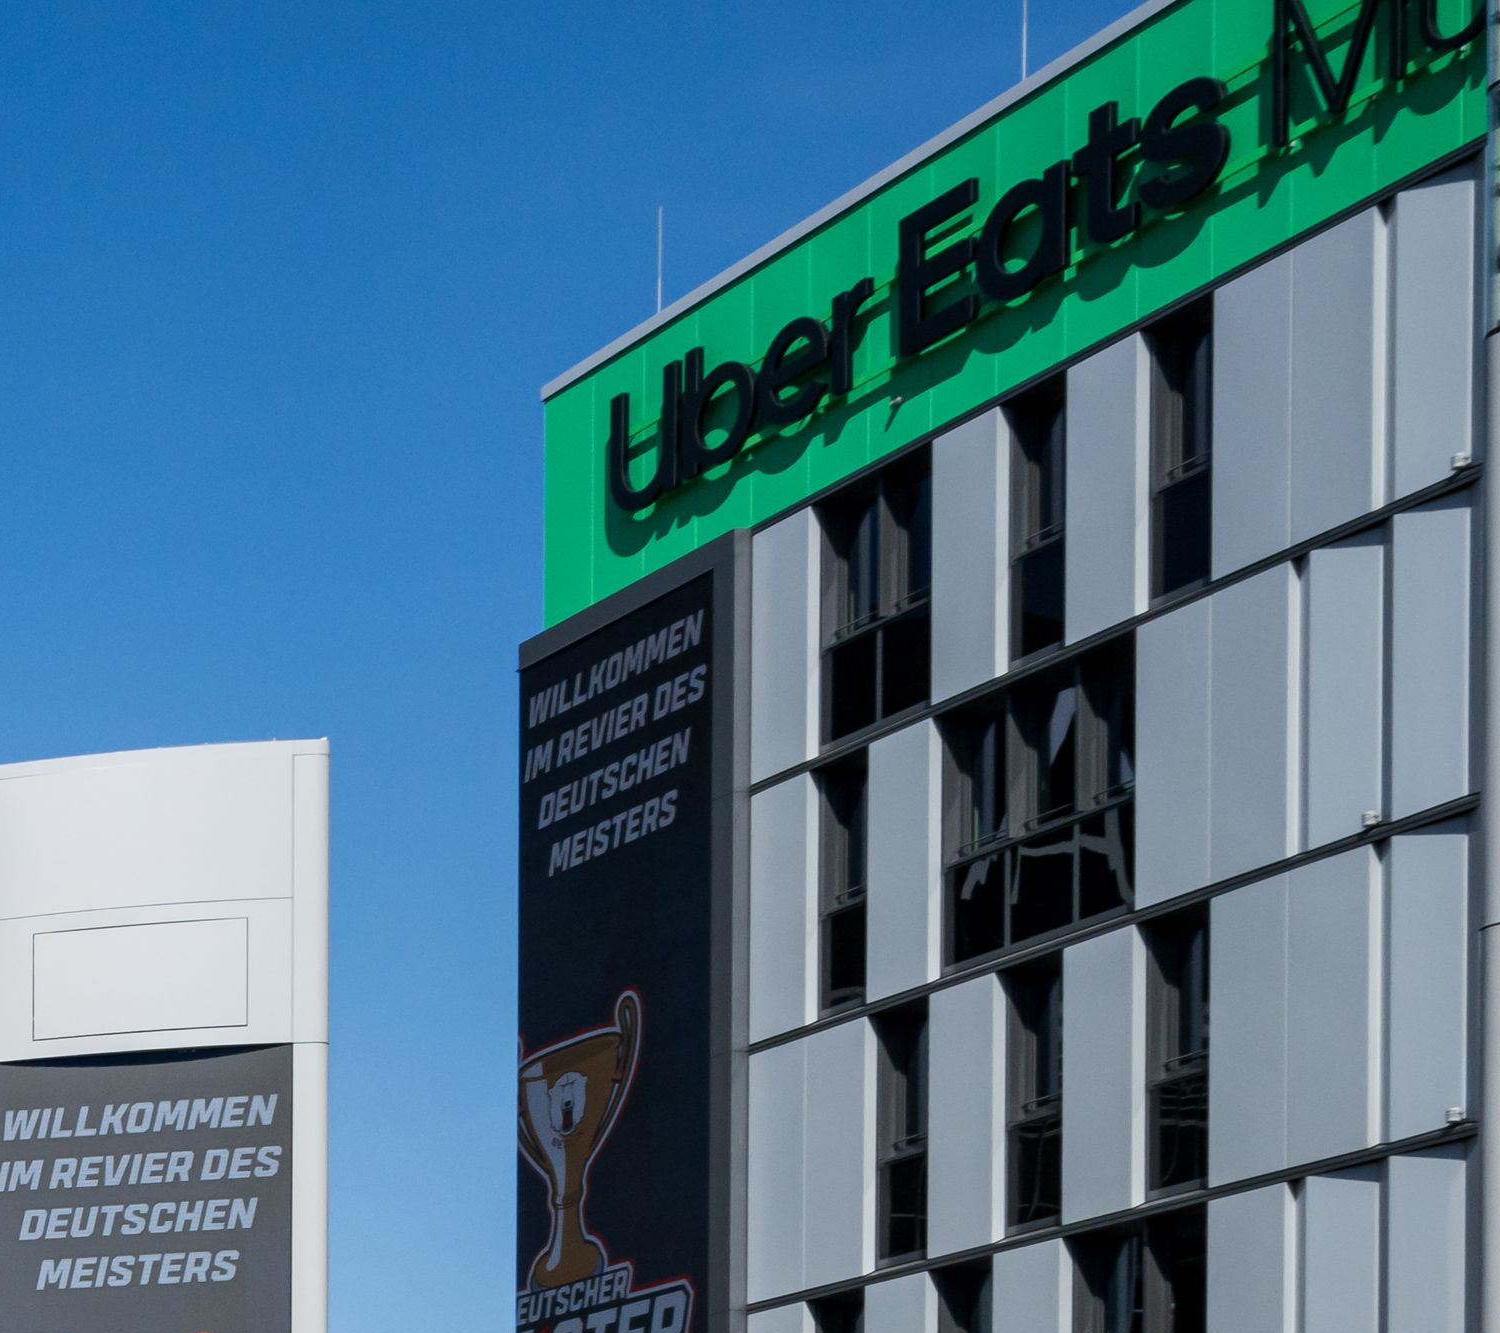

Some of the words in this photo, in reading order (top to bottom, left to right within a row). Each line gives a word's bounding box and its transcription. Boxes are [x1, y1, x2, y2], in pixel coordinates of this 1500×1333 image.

[610, 277, 875, 513] Uber
[900, 76, 1227, 356] Eats
[527, 607, 705, 730] WILLKOMMEN
[524, 743, 553, 784] IM
[556, 704, 647, 770] REVIER
[653, 664, 707, 723] DES
[538, 727, 692, 831] DEUTSCHEN
[549, 788, 679, 879] MEISTERS
[3, 1093, 279, 1141] WILLKOMMEN
[49, 1150, 195, 1190] REVIER
[201, 1145, 283, 1181] DES
[18, 1196, 259, 1241] DEUTSCHEN
[36, 1248, 241, 1290] MEISTERS
